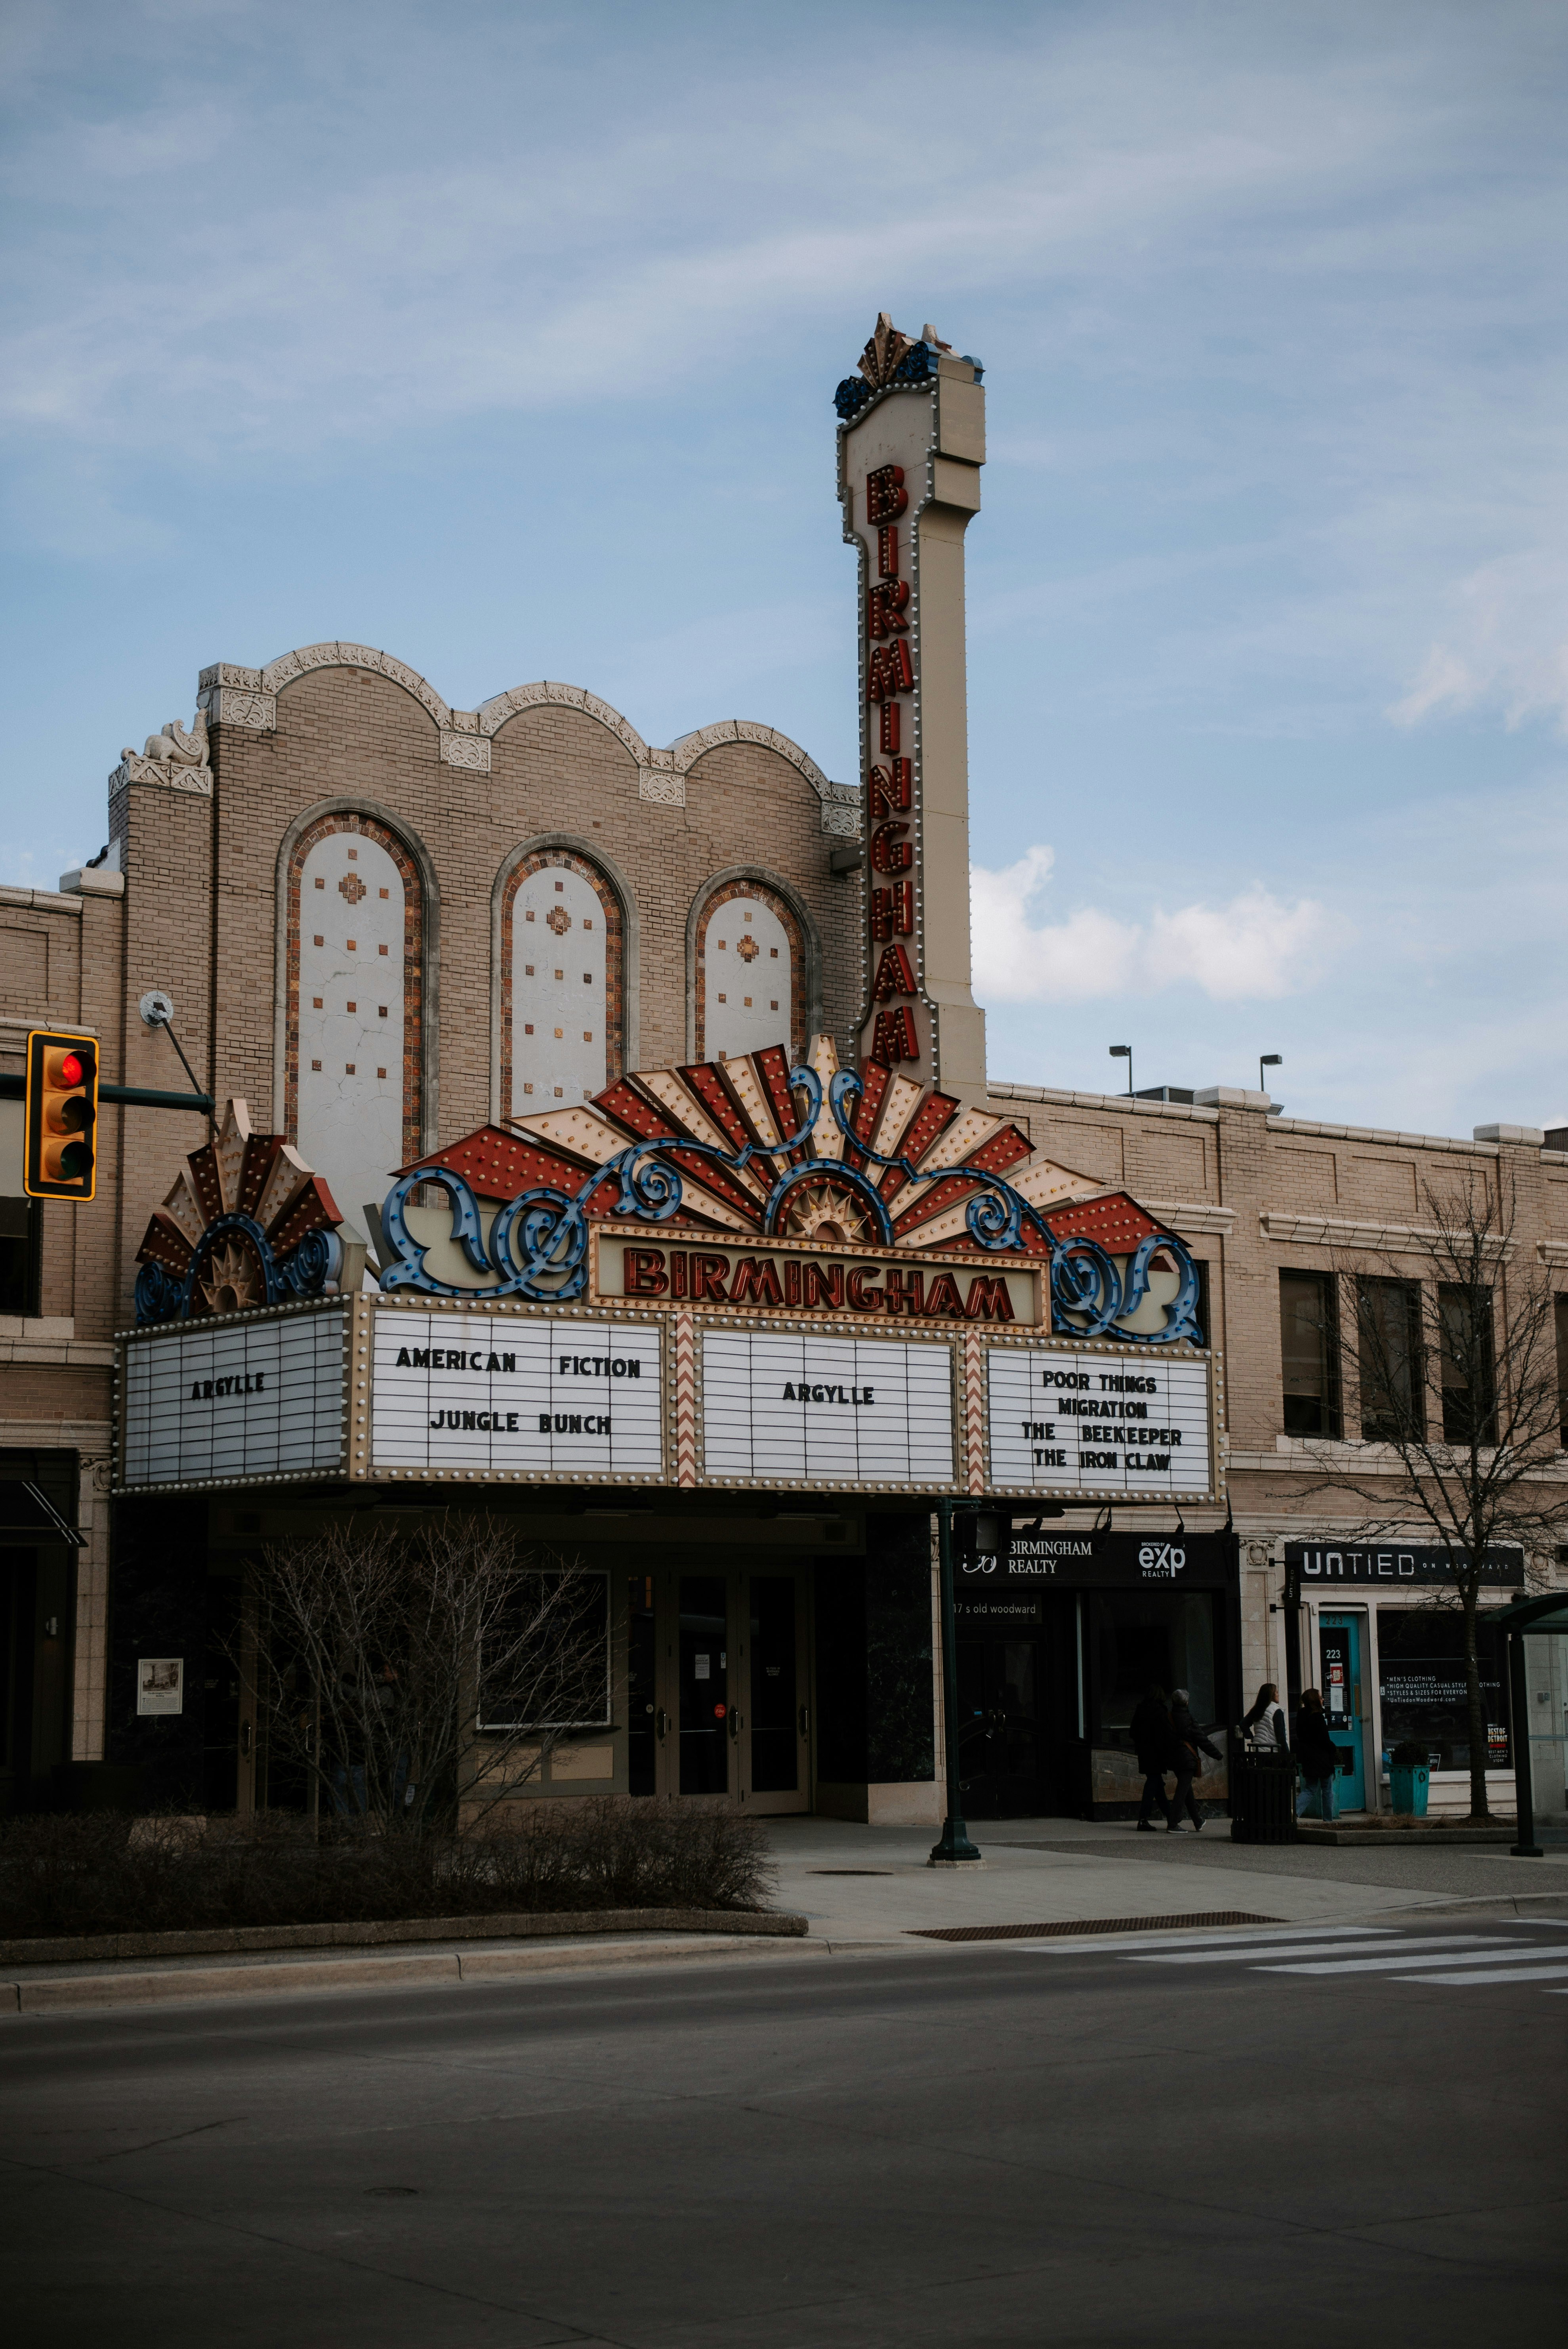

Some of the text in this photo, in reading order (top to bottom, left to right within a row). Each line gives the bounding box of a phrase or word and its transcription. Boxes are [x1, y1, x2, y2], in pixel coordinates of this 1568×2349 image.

[866, 464, 919, 1063] BIRMINGHAM
[624, 1247, 1015, 1320] BIRMINGHAM
[396, 1347, 640, 1378] AMERICAN FICTION
[192, 1372, 264, 1399] ARGYLLE
[783, 1382, 874, 1404] ARGYLLE
[1043, 1371, 1156, 1393] POOR THINGS
[1059, 1398, 1147, 1418] MIGRATION
[431, 1410, 611, 1435] JUNGLE BUNCH
[1022, 1422, 1182, 1446] THE BEEKEEPER
[1034, 1448, 1170, 1471] THE IRON CLAW
[1009, 1541, 1092, 1555] BIRMINGHAM
[1008, 1559, 1057, 1573] REALTY
[973, 1603, 987, 1613] old
[990, 1603, 1036, 1614] woodward
[1326, 1616, 1342, 1624] 223
[1326, 1649, 1341, 1659] 223
